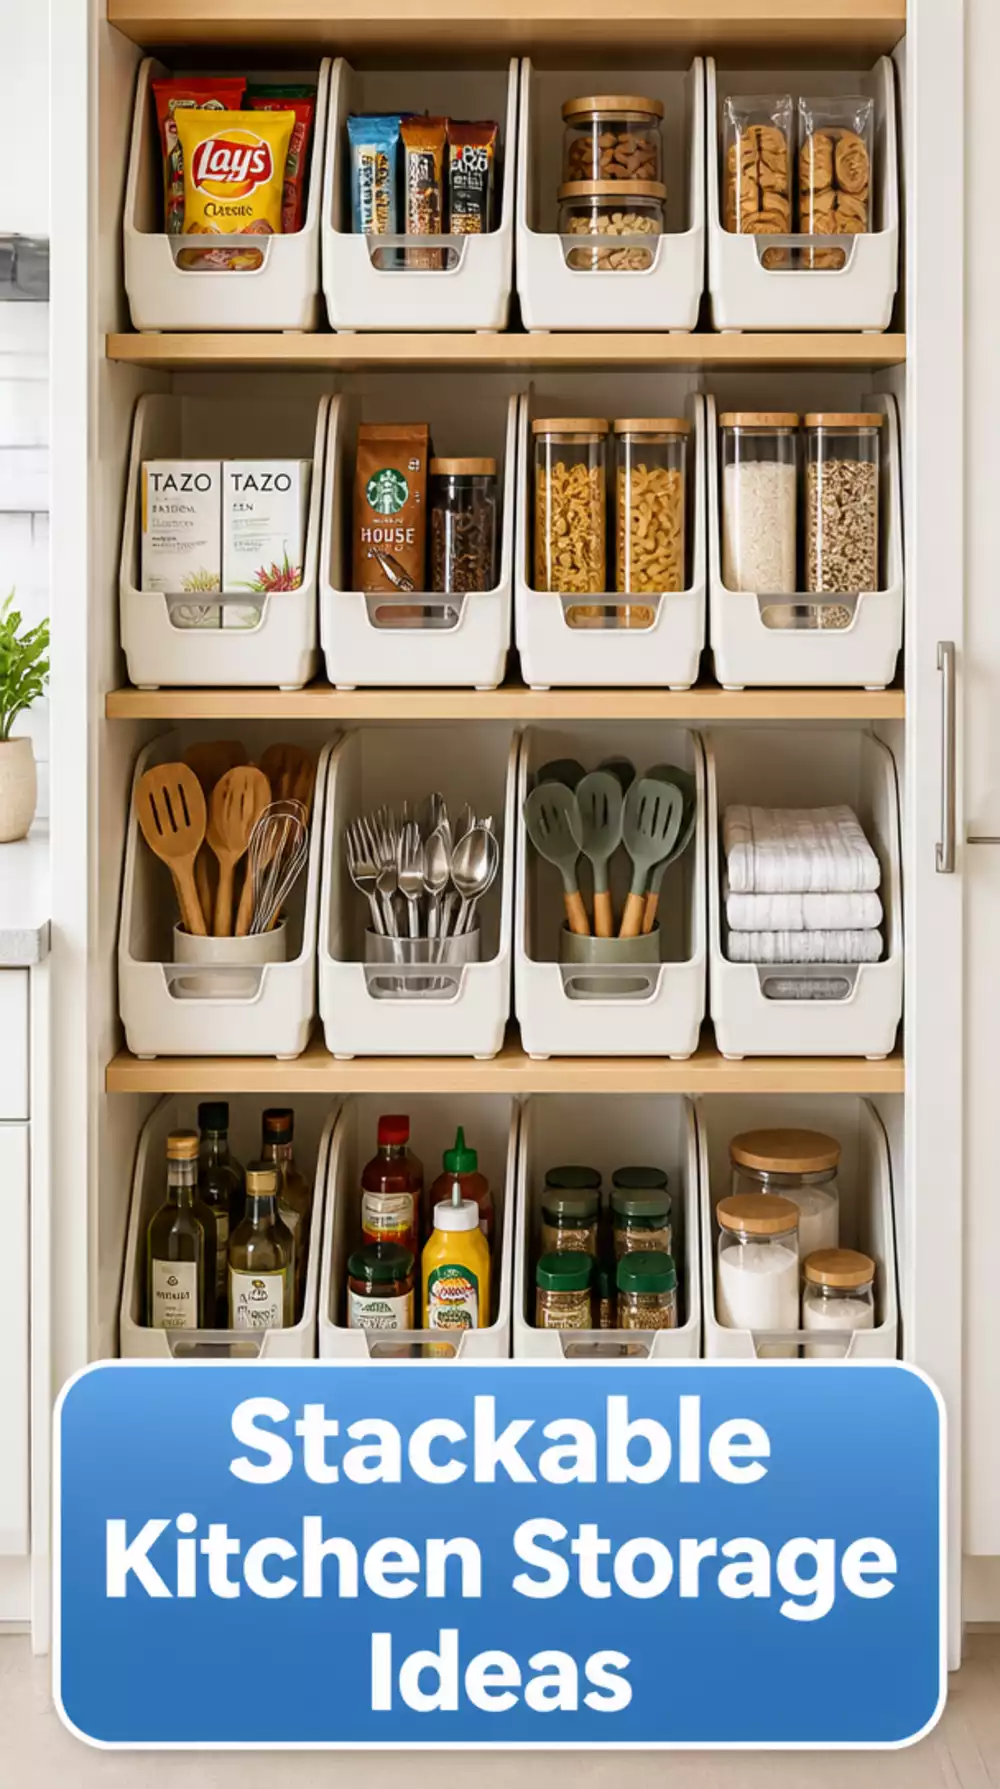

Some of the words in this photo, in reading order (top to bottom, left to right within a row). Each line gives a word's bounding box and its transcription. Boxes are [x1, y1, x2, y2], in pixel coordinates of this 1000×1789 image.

[150, 473, 212, 492] TAZO
[231, 473, 292, 492] TAZO
[360, 527, 416, 544] HOUSE
